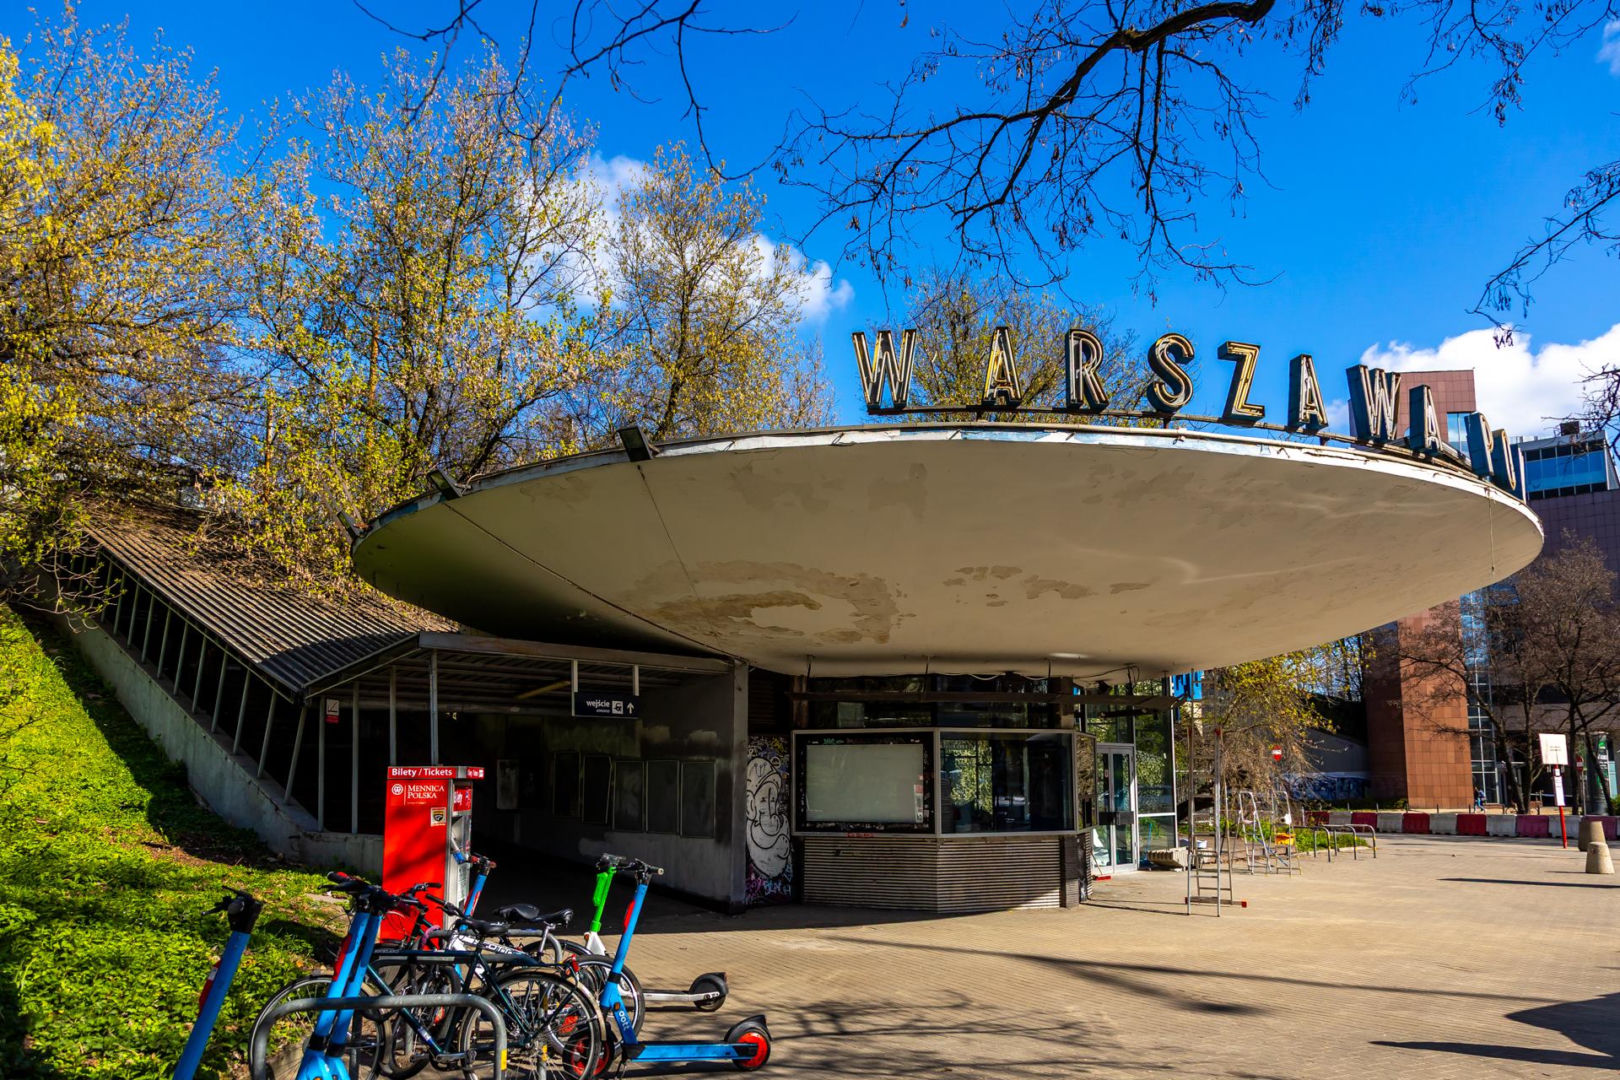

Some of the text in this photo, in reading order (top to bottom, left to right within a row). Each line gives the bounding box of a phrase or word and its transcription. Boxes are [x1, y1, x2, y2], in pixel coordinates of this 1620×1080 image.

[852, 326, 1442, 454] WARSZAWA
[391, 768, 416, 777] Bilety
[424, 768, 453, 776] Tickets
[407, 784, 445, 792] MENNICA
